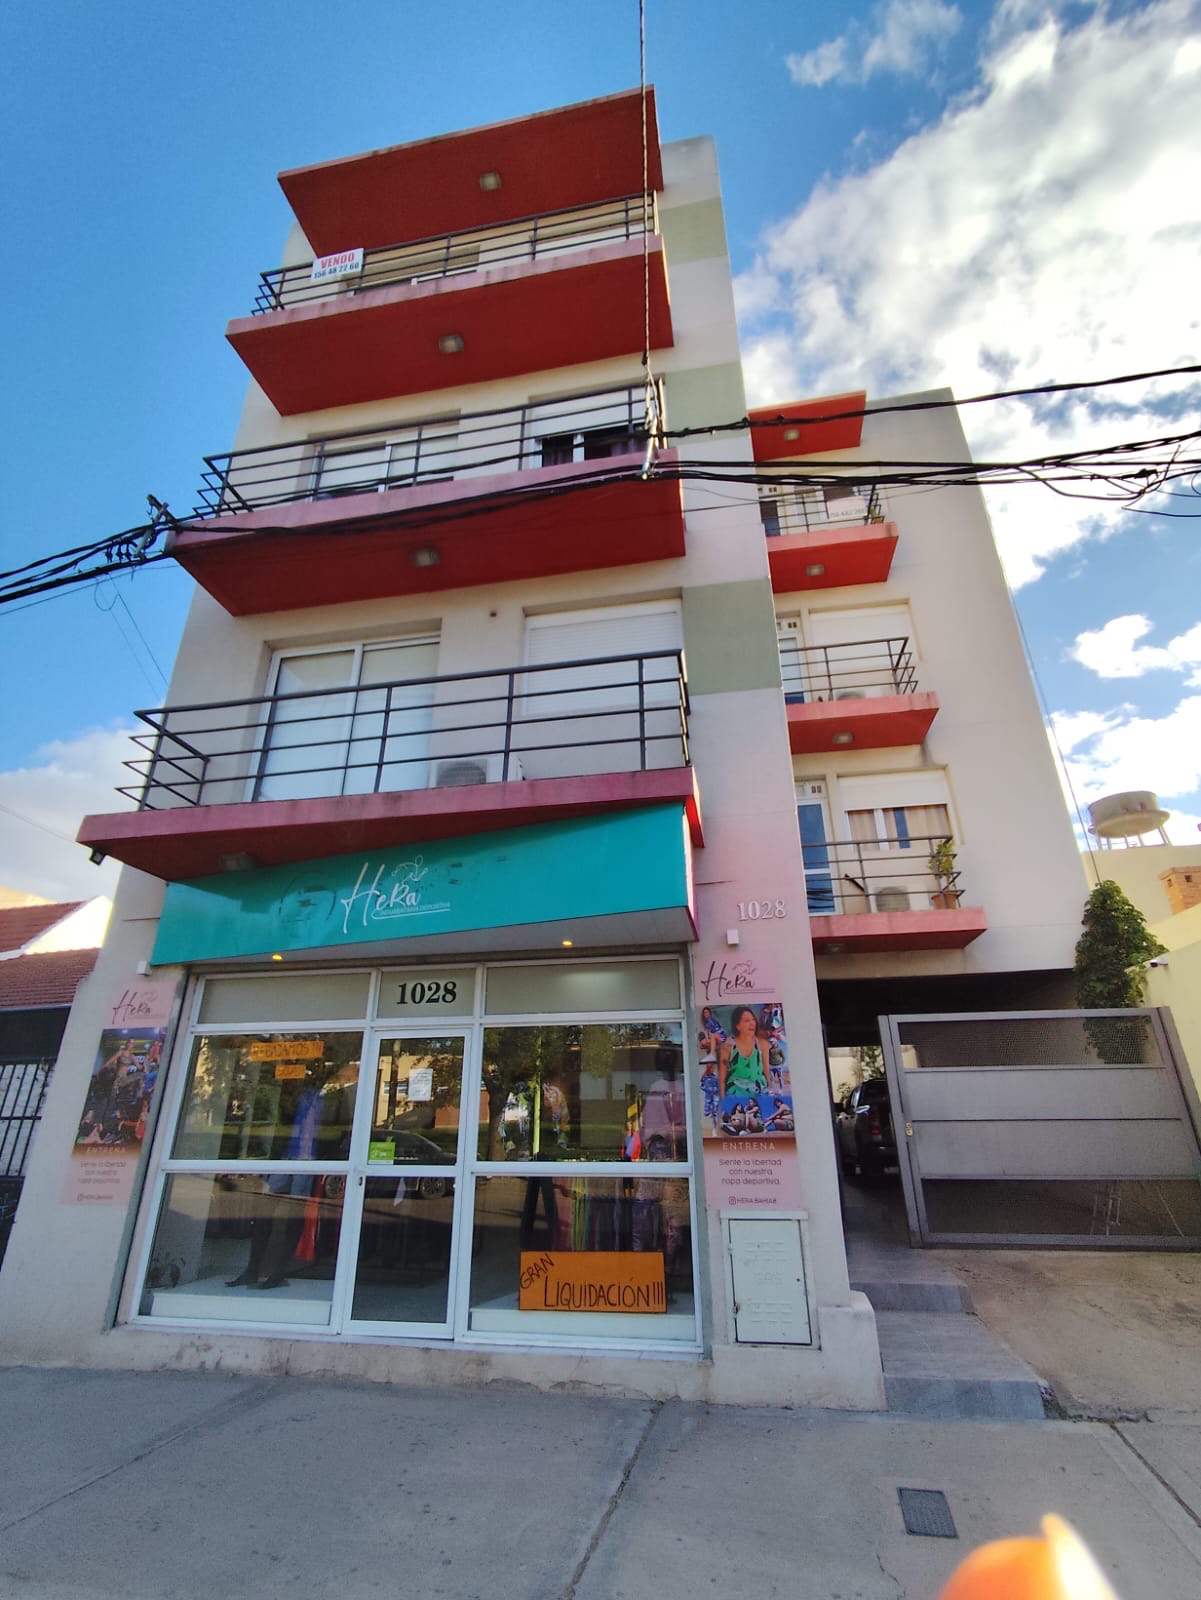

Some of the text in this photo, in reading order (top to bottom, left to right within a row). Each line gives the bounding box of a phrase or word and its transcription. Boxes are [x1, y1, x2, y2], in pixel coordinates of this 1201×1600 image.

[321, 252, 354, 268] VENDO
[738, 899, 786, 921] 1028
[396, 981, 457, 1005] 1028
[722, 1142, 776, 1151] ENTRENA
[753, 1158, 782, 1166] libertad
[744, 1168, 773, 1176] nuestra
[721, 1178, 780, 1186] ropa deportiva
[519, 1252, 555, 1290] GRAN
